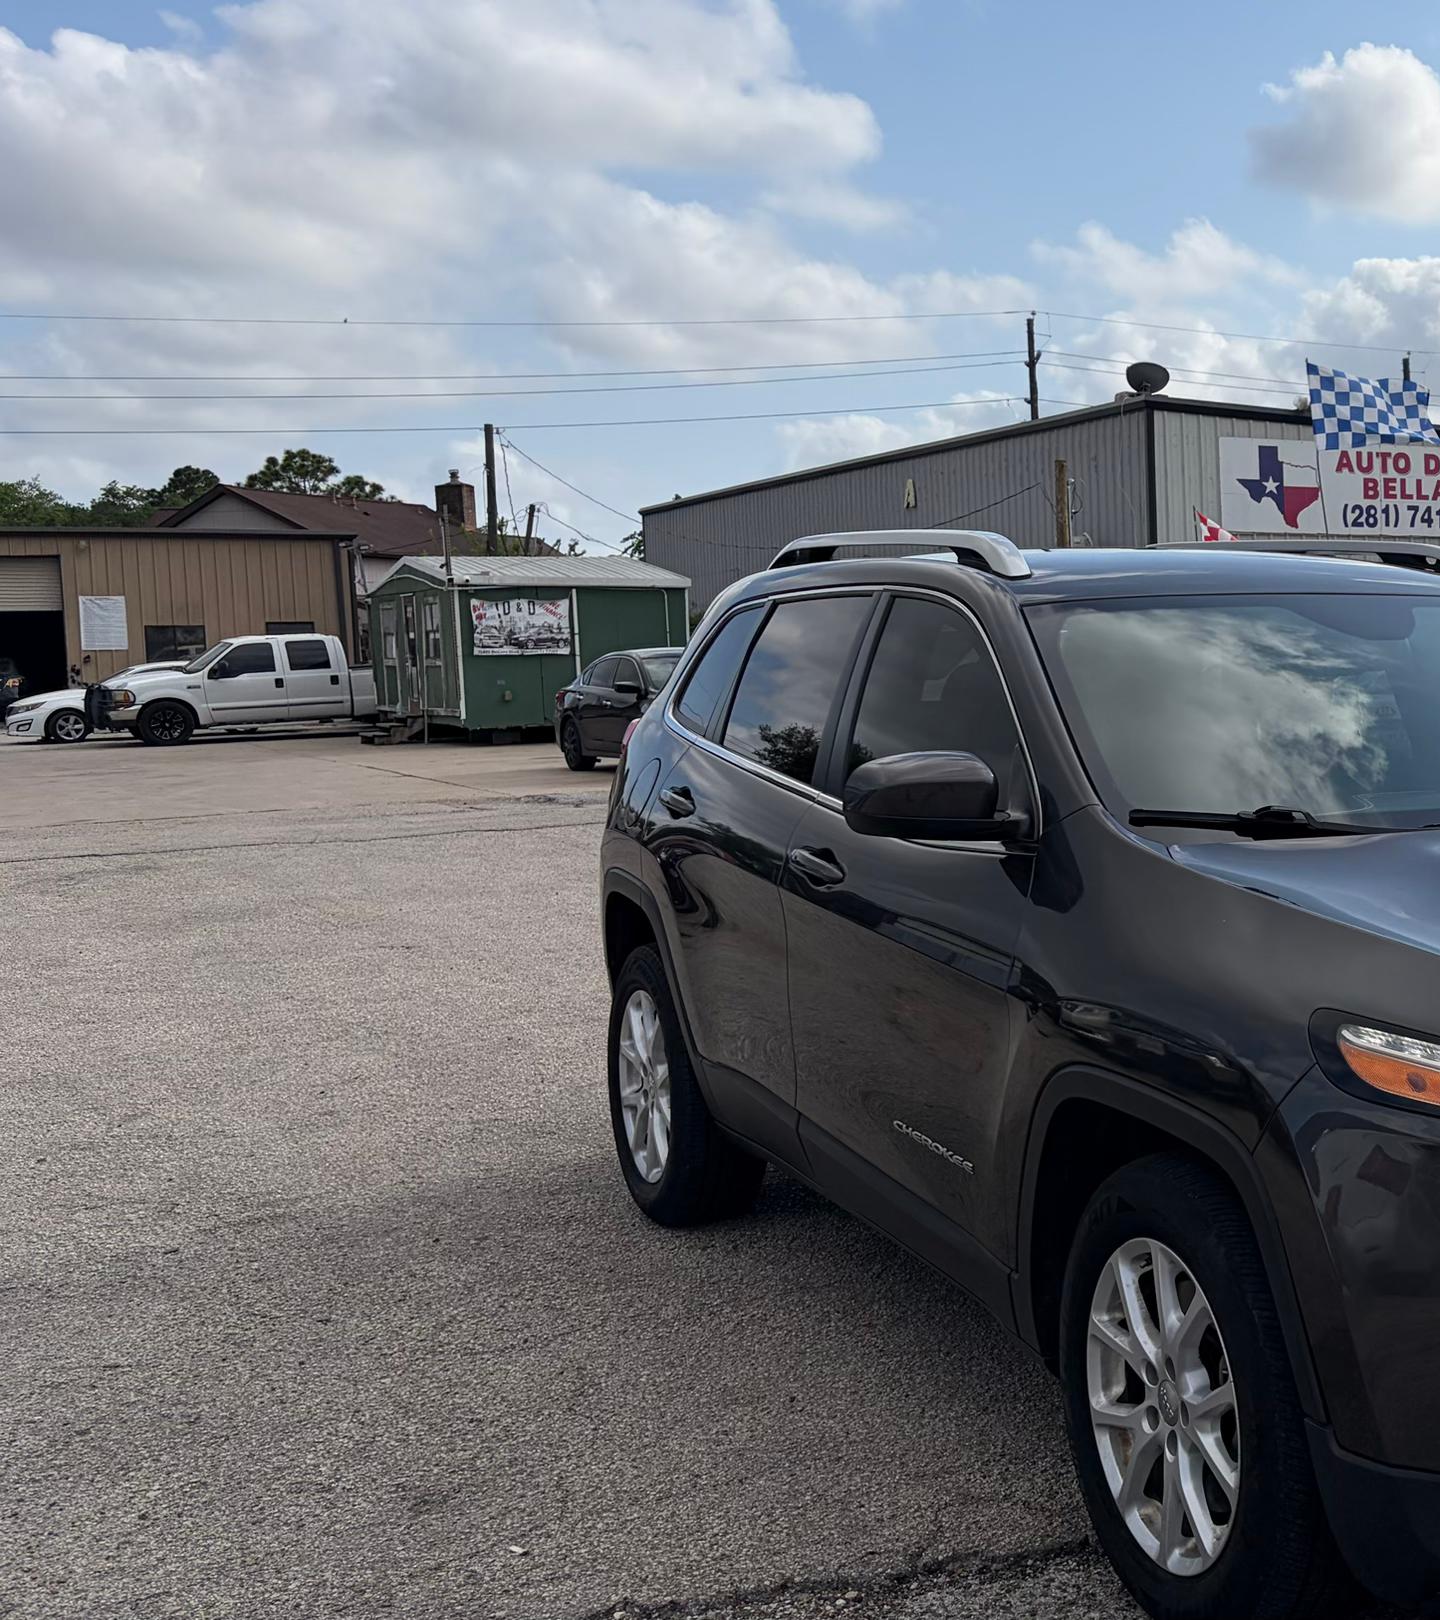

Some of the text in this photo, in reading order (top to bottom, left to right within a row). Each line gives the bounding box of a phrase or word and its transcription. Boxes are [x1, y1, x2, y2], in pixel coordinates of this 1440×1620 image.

[1335, 450, 1411, 475] AUTO
[1342, 504, 1399, 528] (281)
[893, 1120, 974, 1175] CHEROKEE
